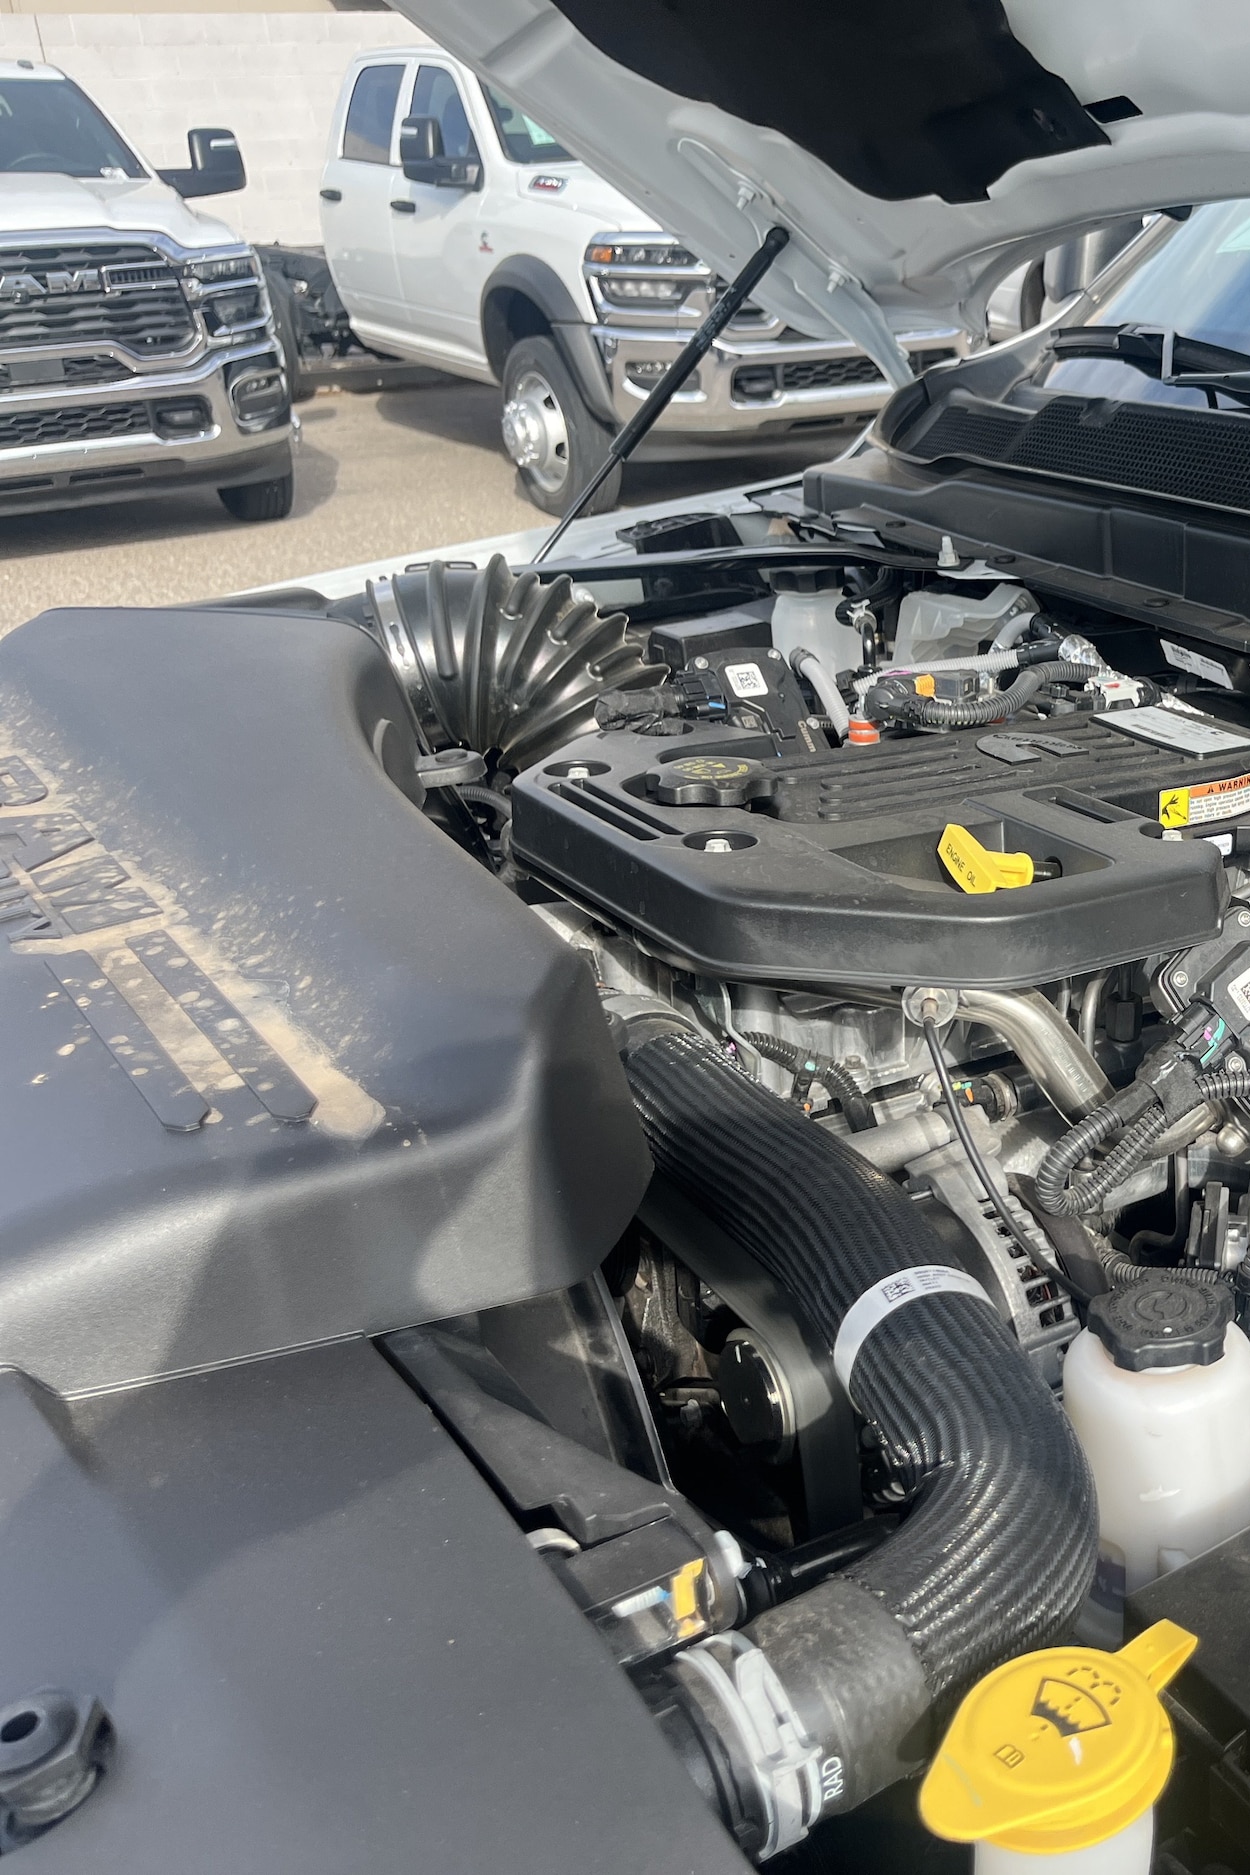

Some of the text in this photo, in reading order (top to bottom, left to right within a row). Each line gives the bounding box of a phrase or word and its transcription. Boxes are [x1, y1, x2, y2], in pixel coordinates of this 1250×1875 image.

[0, 269, 100, 297] AM
[798, 720, 816, 752] Cumm
[946, 843, 976, 887] ENGINE OIL
[822, 1756, 843, 1800] RAD
